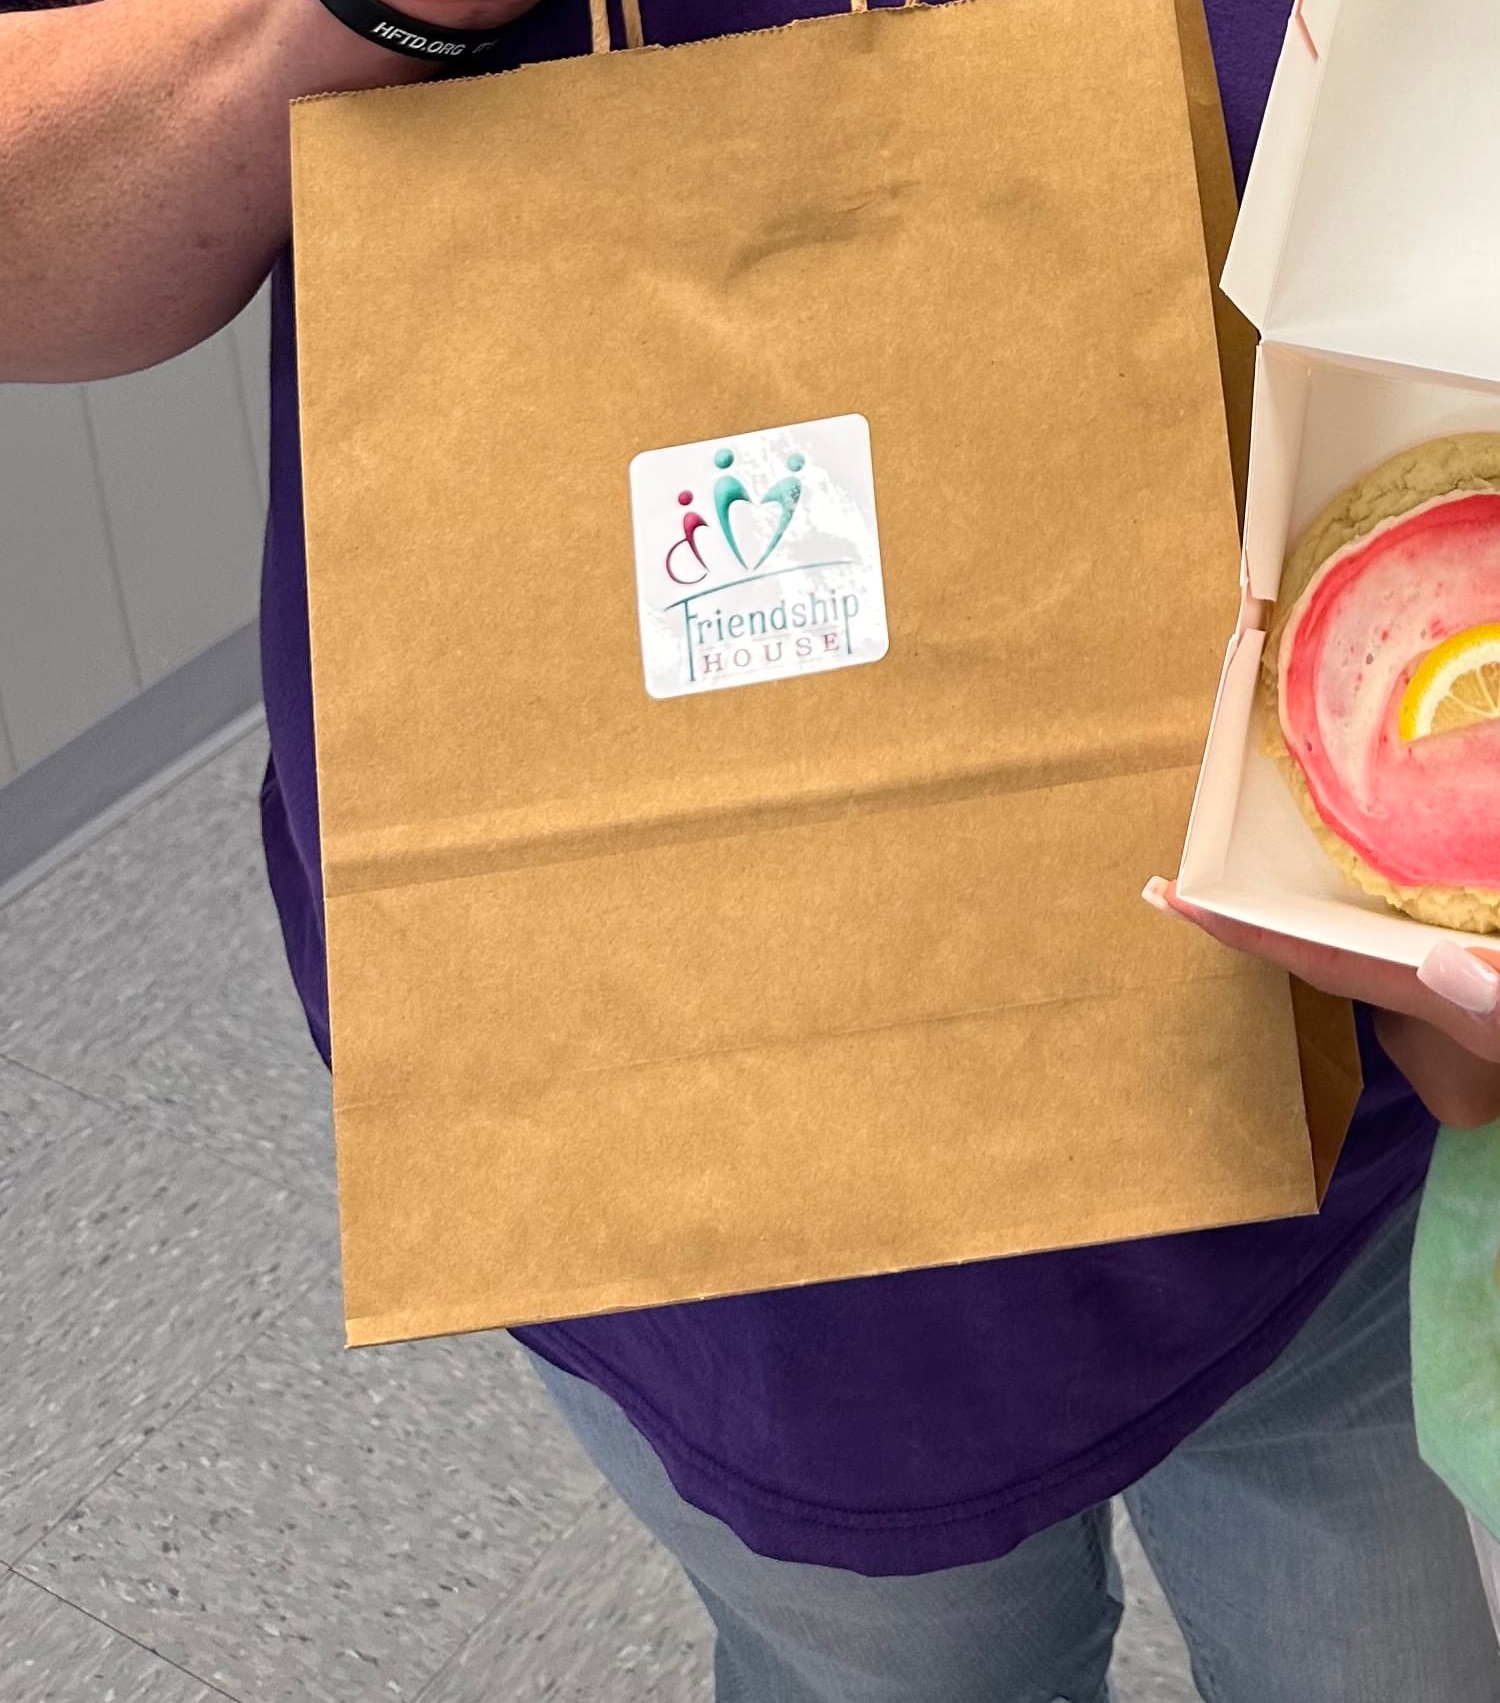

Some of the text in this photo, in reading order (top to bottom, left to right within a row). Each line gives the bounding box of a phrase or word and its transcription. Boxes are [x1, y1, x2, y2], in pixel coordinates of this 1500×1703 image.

[371, 21, 467, 56] HFTD.ORG
[682, 589, 860, 682] Friendship
[702, 632, 841, 675] HOUSE
